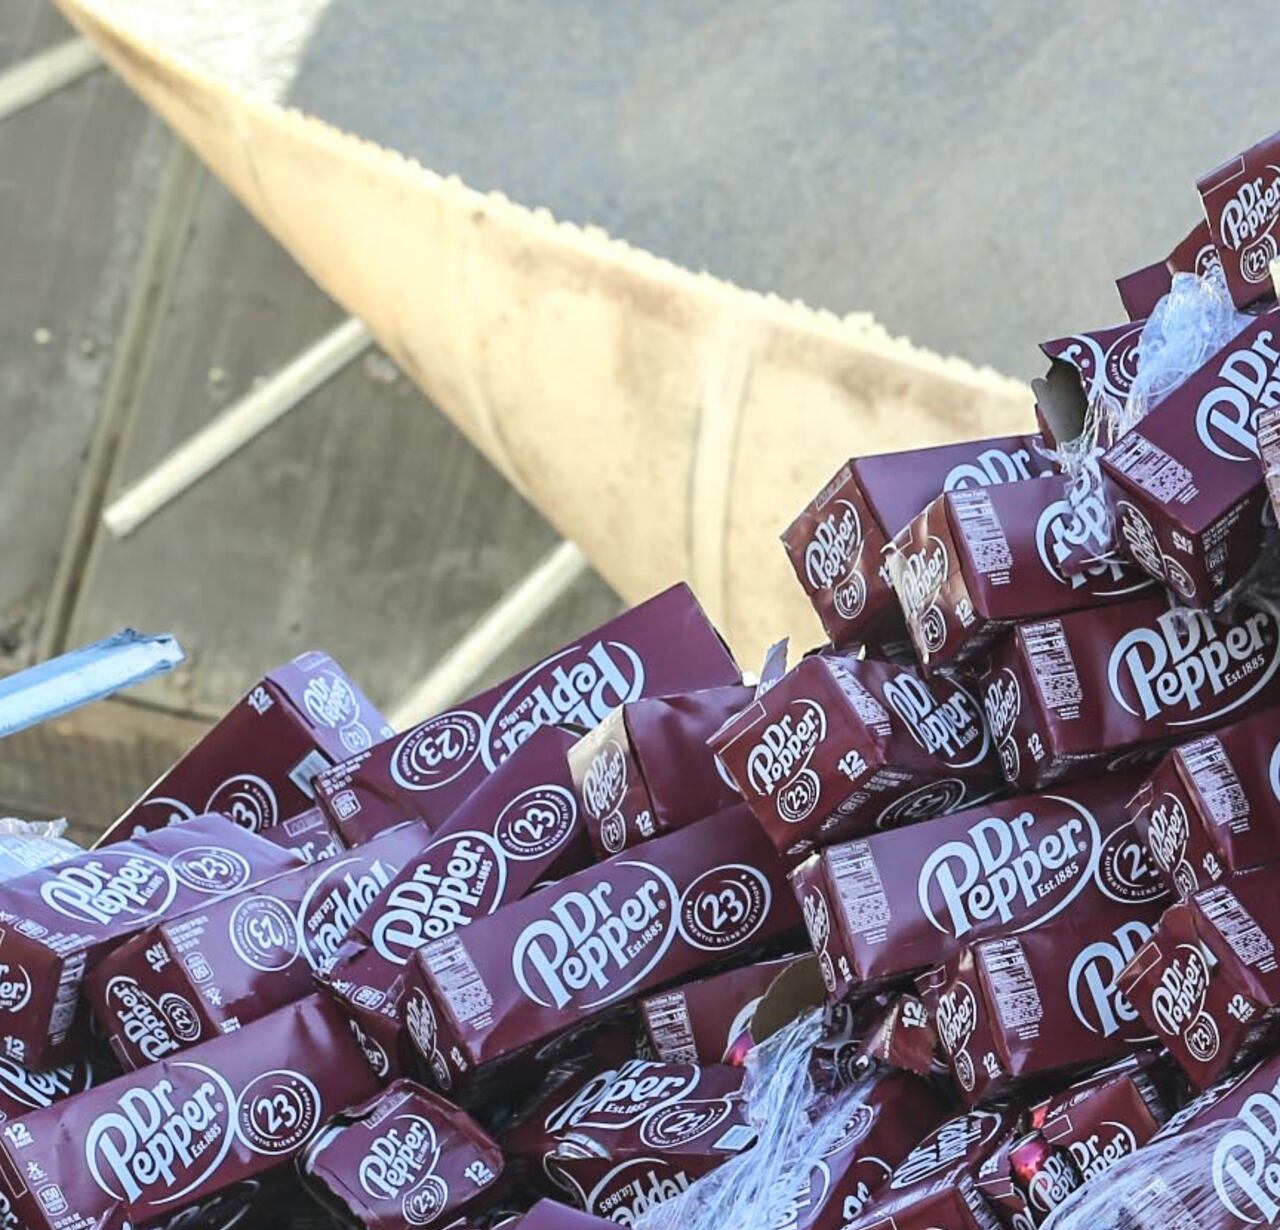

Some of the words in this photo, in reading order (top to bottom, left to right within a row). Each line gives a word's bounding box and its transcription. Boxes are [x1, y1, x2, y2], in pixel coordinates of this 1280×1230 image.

[806, 510, 855, 588] Pepper
[816, 514, 837, 549] Dr
[952, 600, 969, 623] 12
[1108, 612, 1269, 720] Pepper
[1224, 655, 1265, 687] Est.1885
[247, 686, 268, 709] 12
[346, 732, 364, 749] 23
[419, 728, 461, 767] 23
[838, 751, 861, 775] 12
[514, 805, 559, 843] 23
[969, 811, 1033, 864] Dr
[920, 828, 1083, 938] Pepper
[1036, 864, 1081, 898] Est.1885
[562, 872, 627, 935] Dr
[698, 887, 743, 930] 23
[514, 882, 661, 1007] Pepper
[626, 920, 664, 961] Est.1885
[124, 1081, 175, 1138] Dr
[256, 1091, 297, 1131] 23
[87, 1082, 220, 1202] Pepper
[192, 1123, 223, 1158] Est.1885
